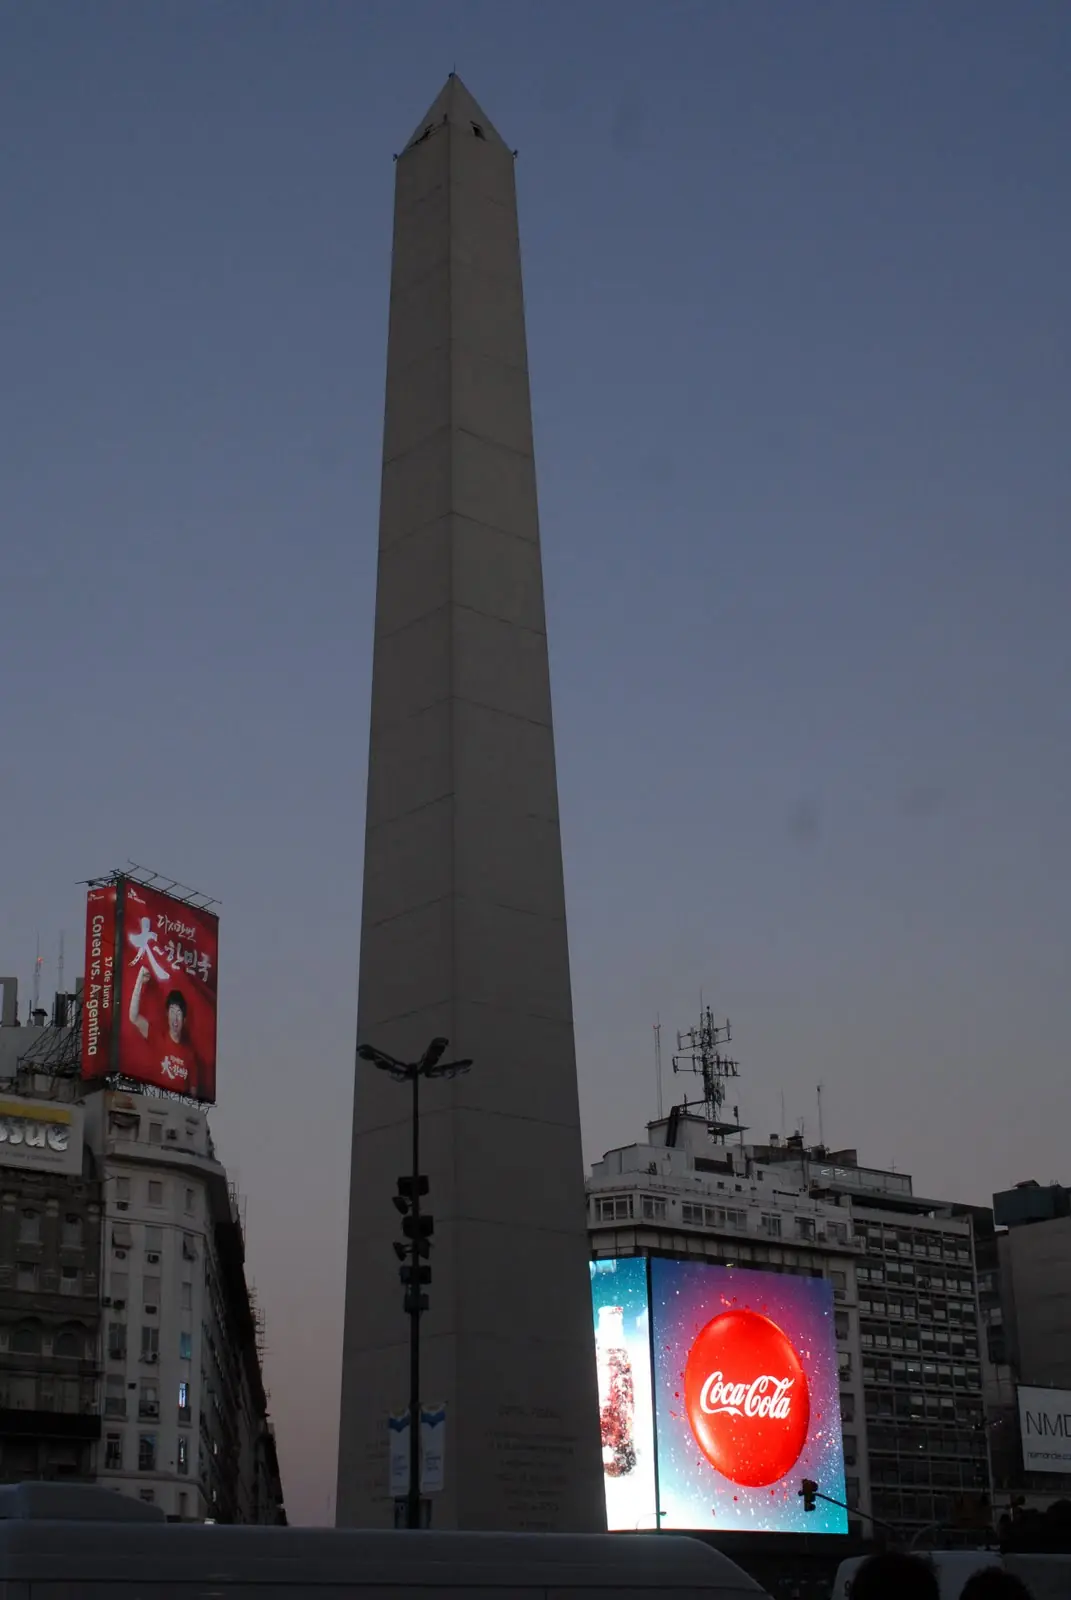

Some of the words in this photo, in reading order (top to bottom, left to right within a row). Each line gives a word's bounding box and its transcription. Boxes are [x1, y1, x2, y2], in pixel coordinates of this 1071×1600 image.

[91, 914, 104, 957] Corea
[90, 959, 101, 981] vs.
[103, 970, 113, 983] de
[104, 956, 113, 968] 17
[86, 984, 102, 1056] Argentina
[699, 1371, 795, 1420] Coca-Cola
